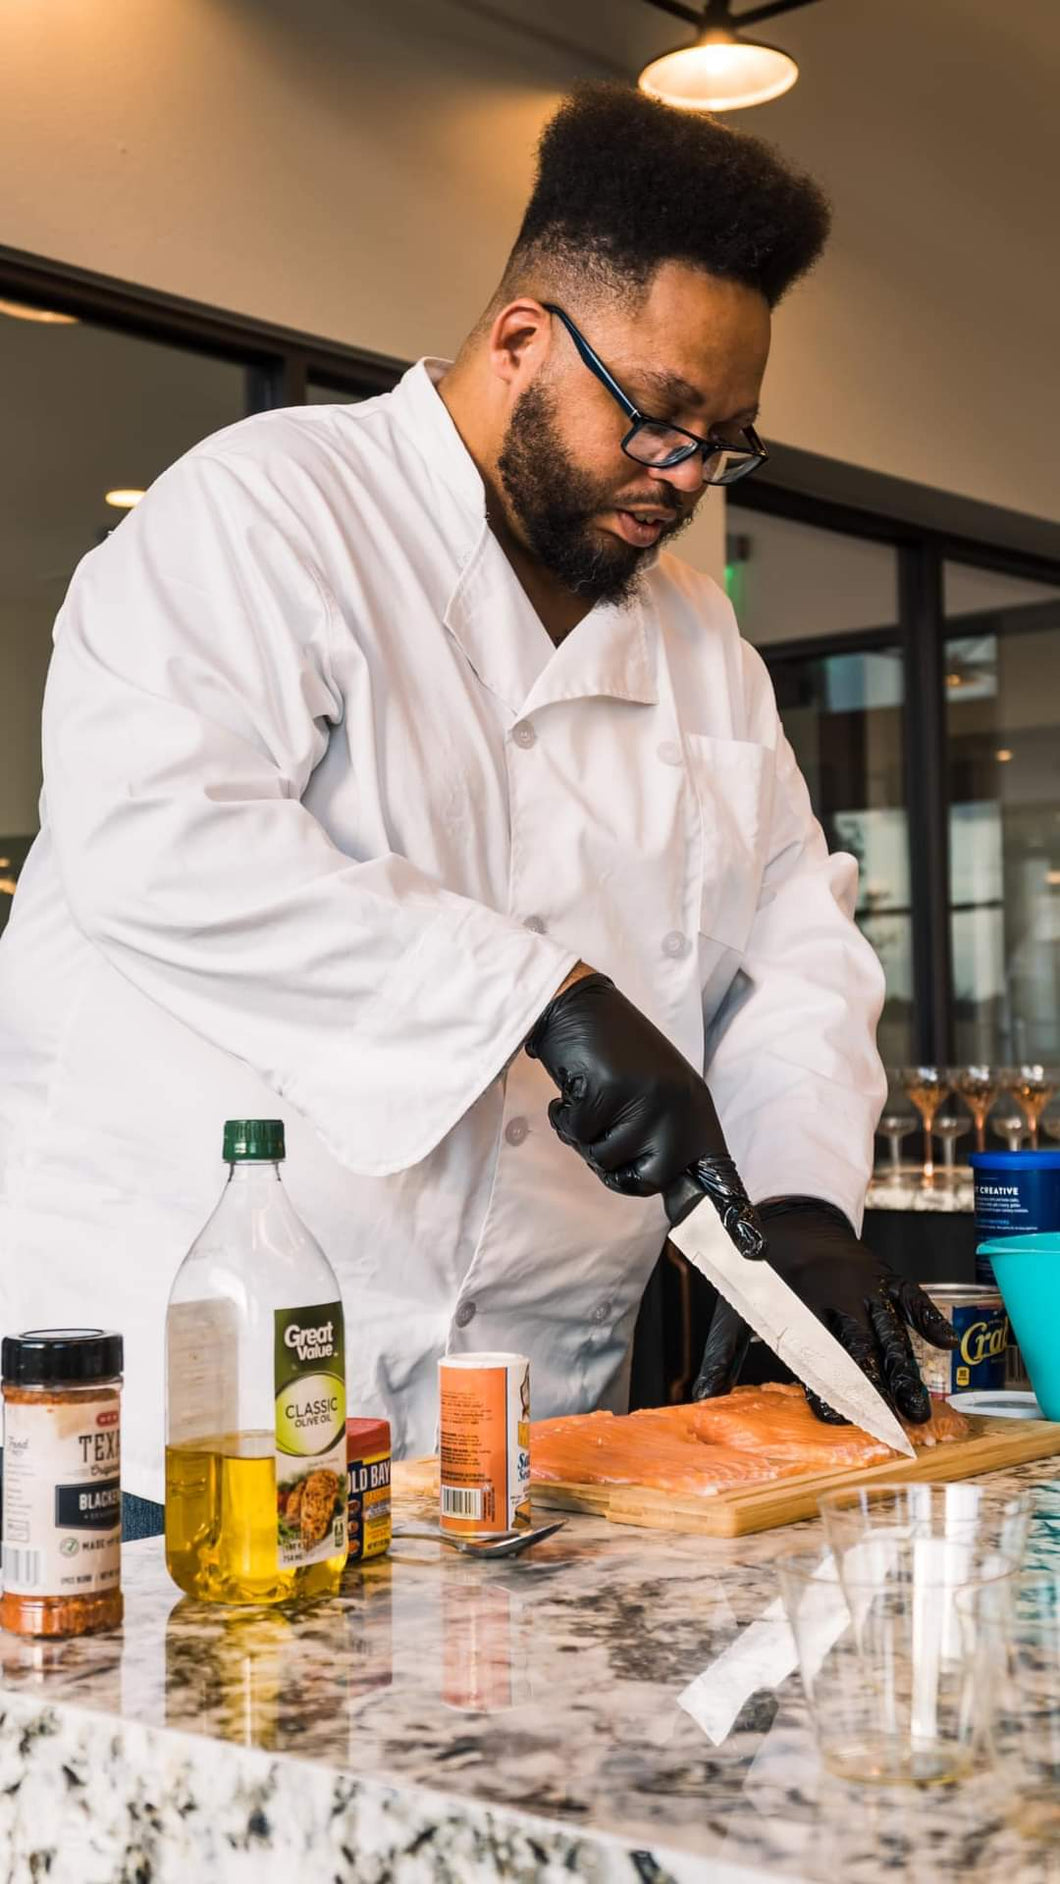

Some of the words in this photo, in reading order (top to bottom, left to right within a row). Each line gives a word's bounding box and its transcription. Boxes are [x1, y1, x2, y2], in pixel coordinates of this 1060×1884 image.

[980, 1186, 1019, 1196] CREATIVE
[284, 1321, 334, 1348] Great
[296, 1343, 333, 1361] Value
[285, 1397, 338, 1419] CLASSIC
[295, 1415, 319, 1428] OLIVE
[320, 1414, 332, 1424] OIL
[371, 1460, 391, 1489] BAY
